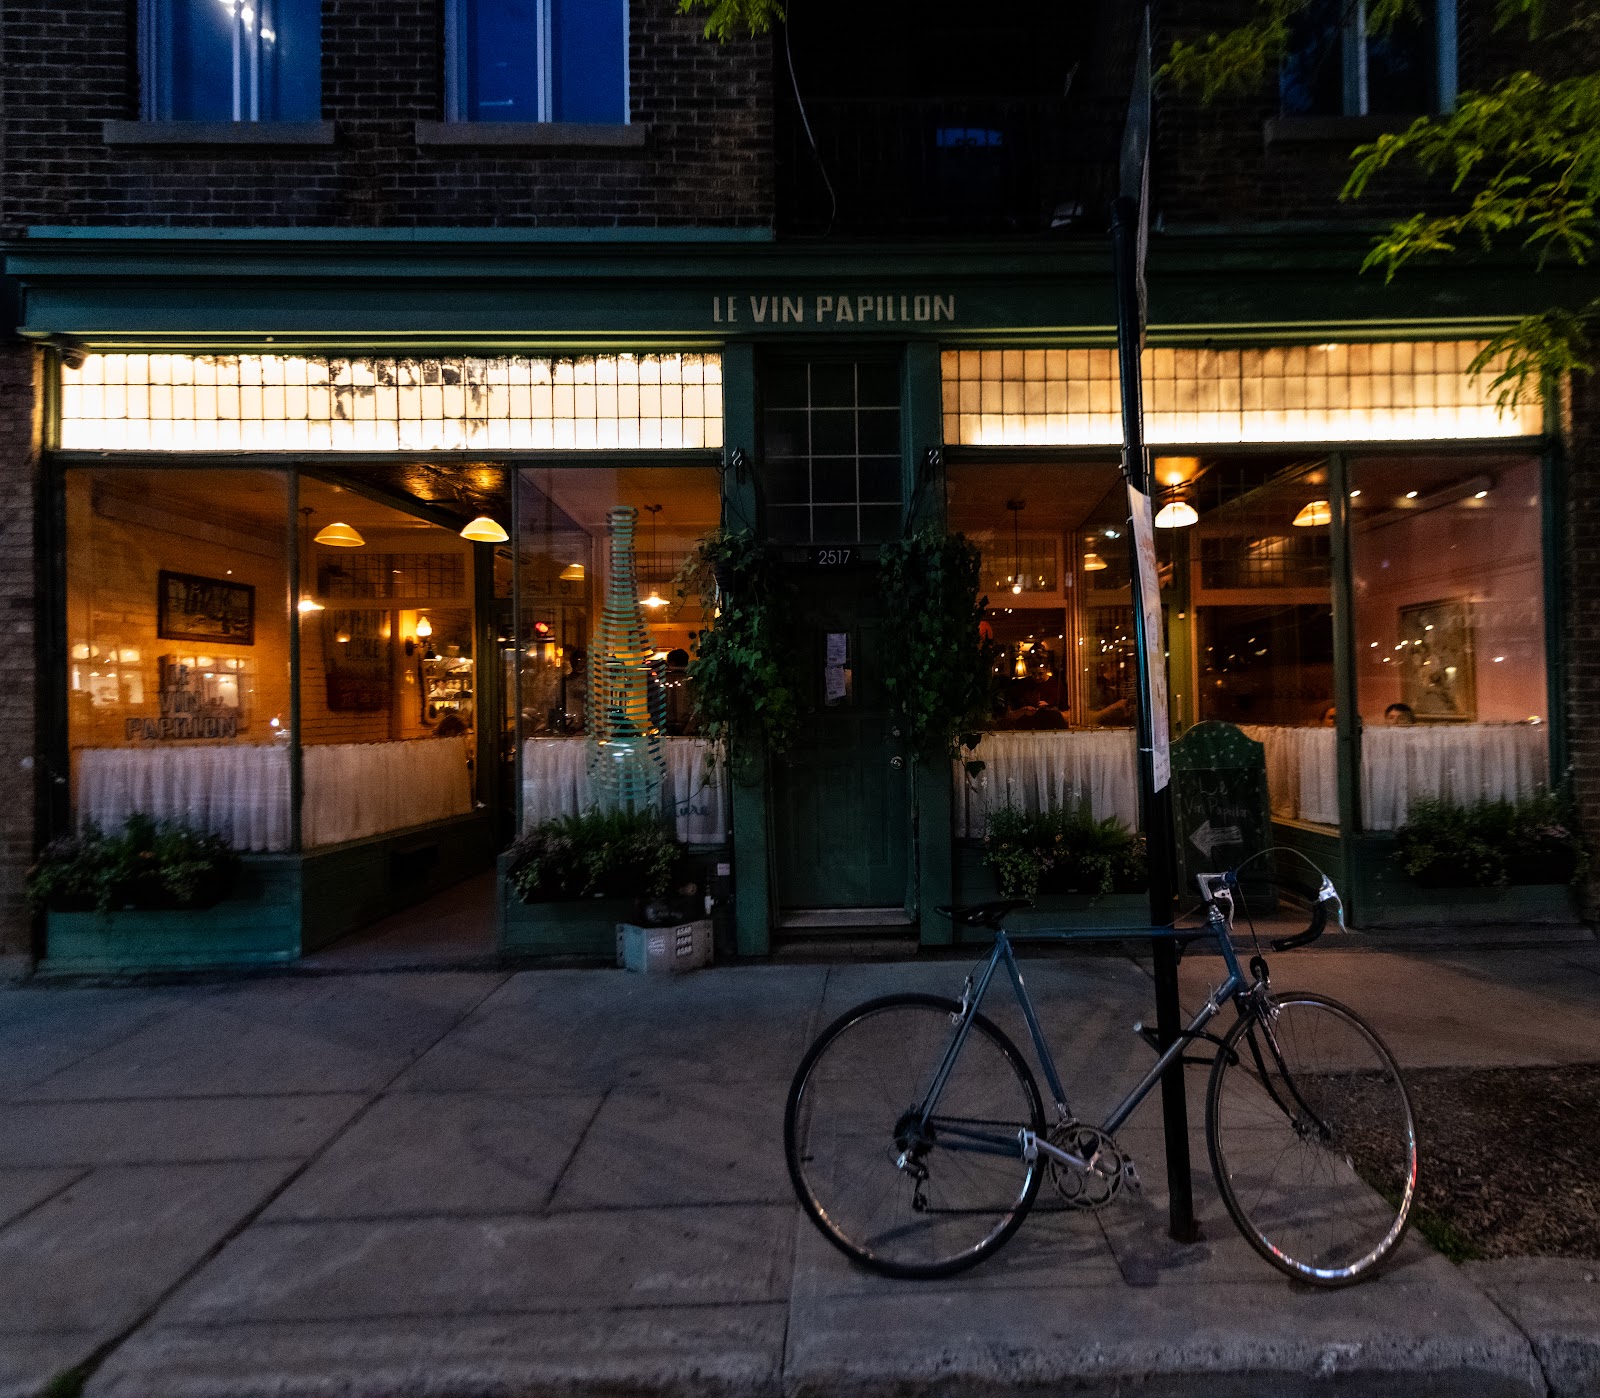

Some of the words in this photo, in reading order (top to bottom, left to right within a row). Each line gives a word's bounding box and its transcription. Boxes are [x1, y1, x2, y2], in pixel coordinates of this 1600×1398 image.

[713, 296, 738, 323] LE
[750, 296, 804, 323] VIN
[816, 294, 955, 323] PAPILLON
[818, 550, 851, 565] 2517
[159, 690, 203, 714] VIN
[124, 716, 238, 741] PAPILLON
